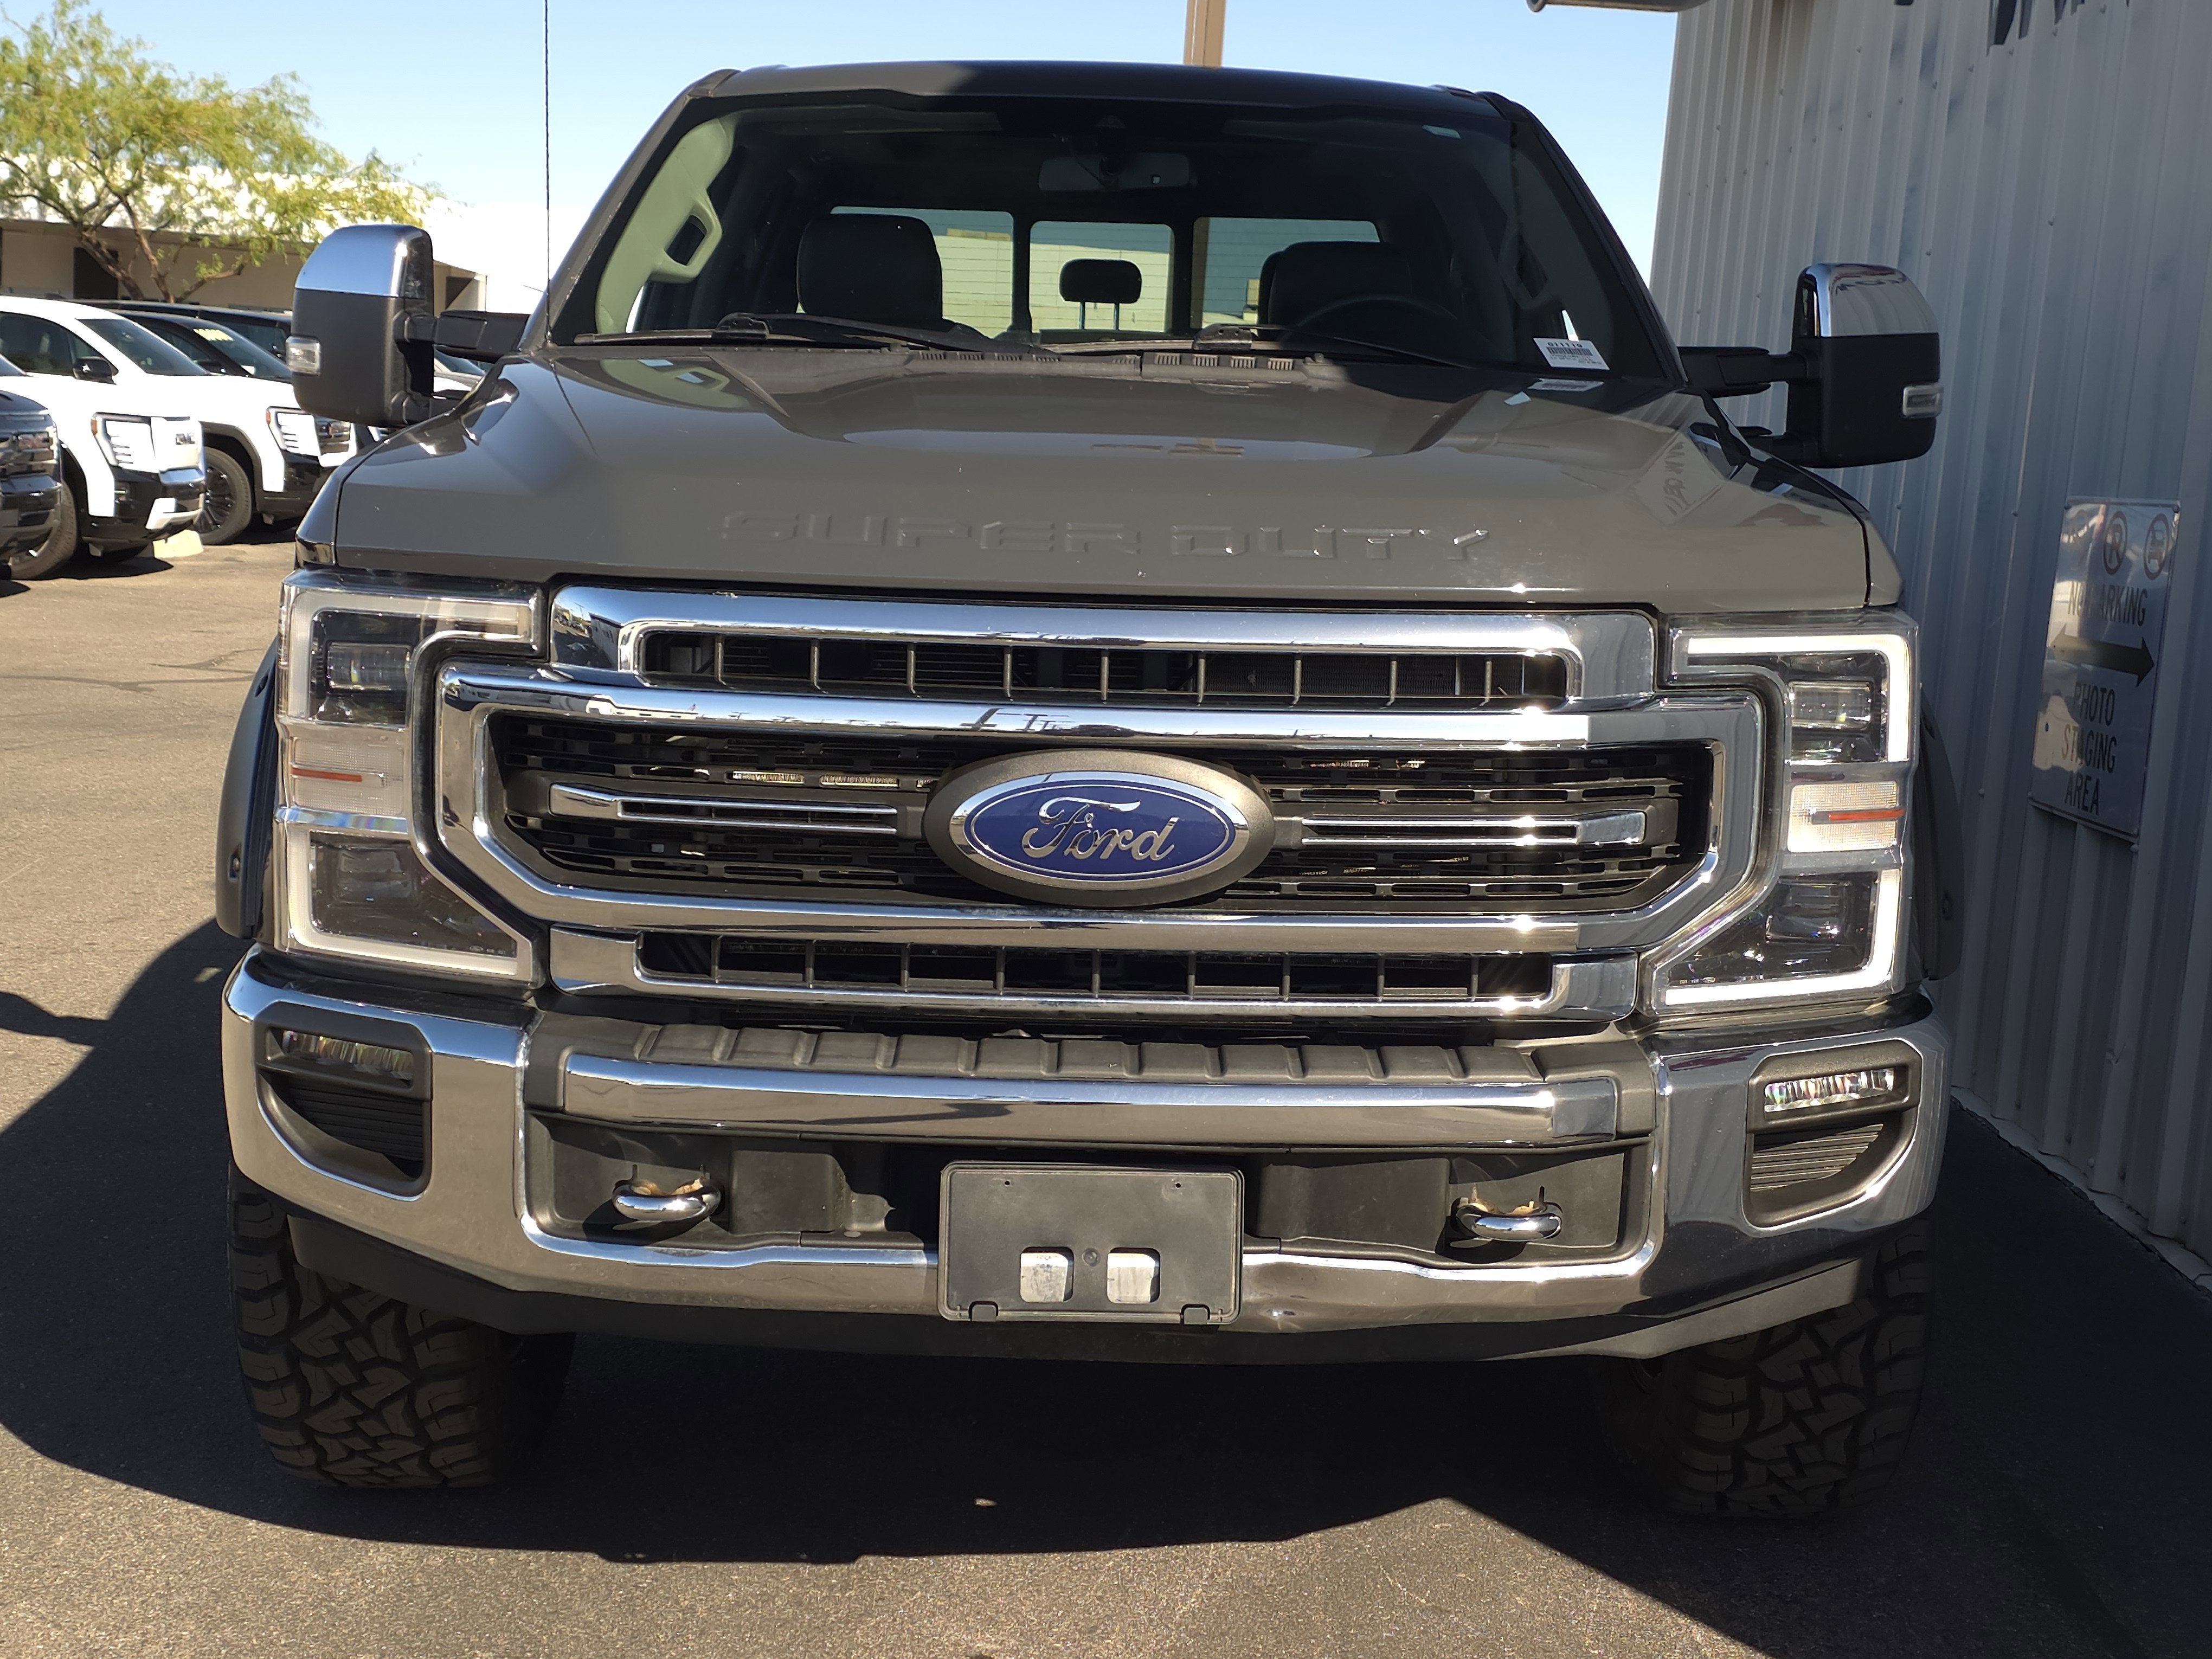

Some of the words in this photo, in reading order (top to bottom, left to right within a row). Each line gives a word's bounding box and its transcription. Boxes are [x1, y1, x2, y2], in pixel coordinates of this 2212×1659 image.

[721, 511, 1141, 554] SUPER
[1170, 524, 1489, 561] DUTY
[2073, 681, 2115, 727] PHOTO
[2065, 770, 2100, 815] AREA
[1020, 795, 1180, 861] Ford
